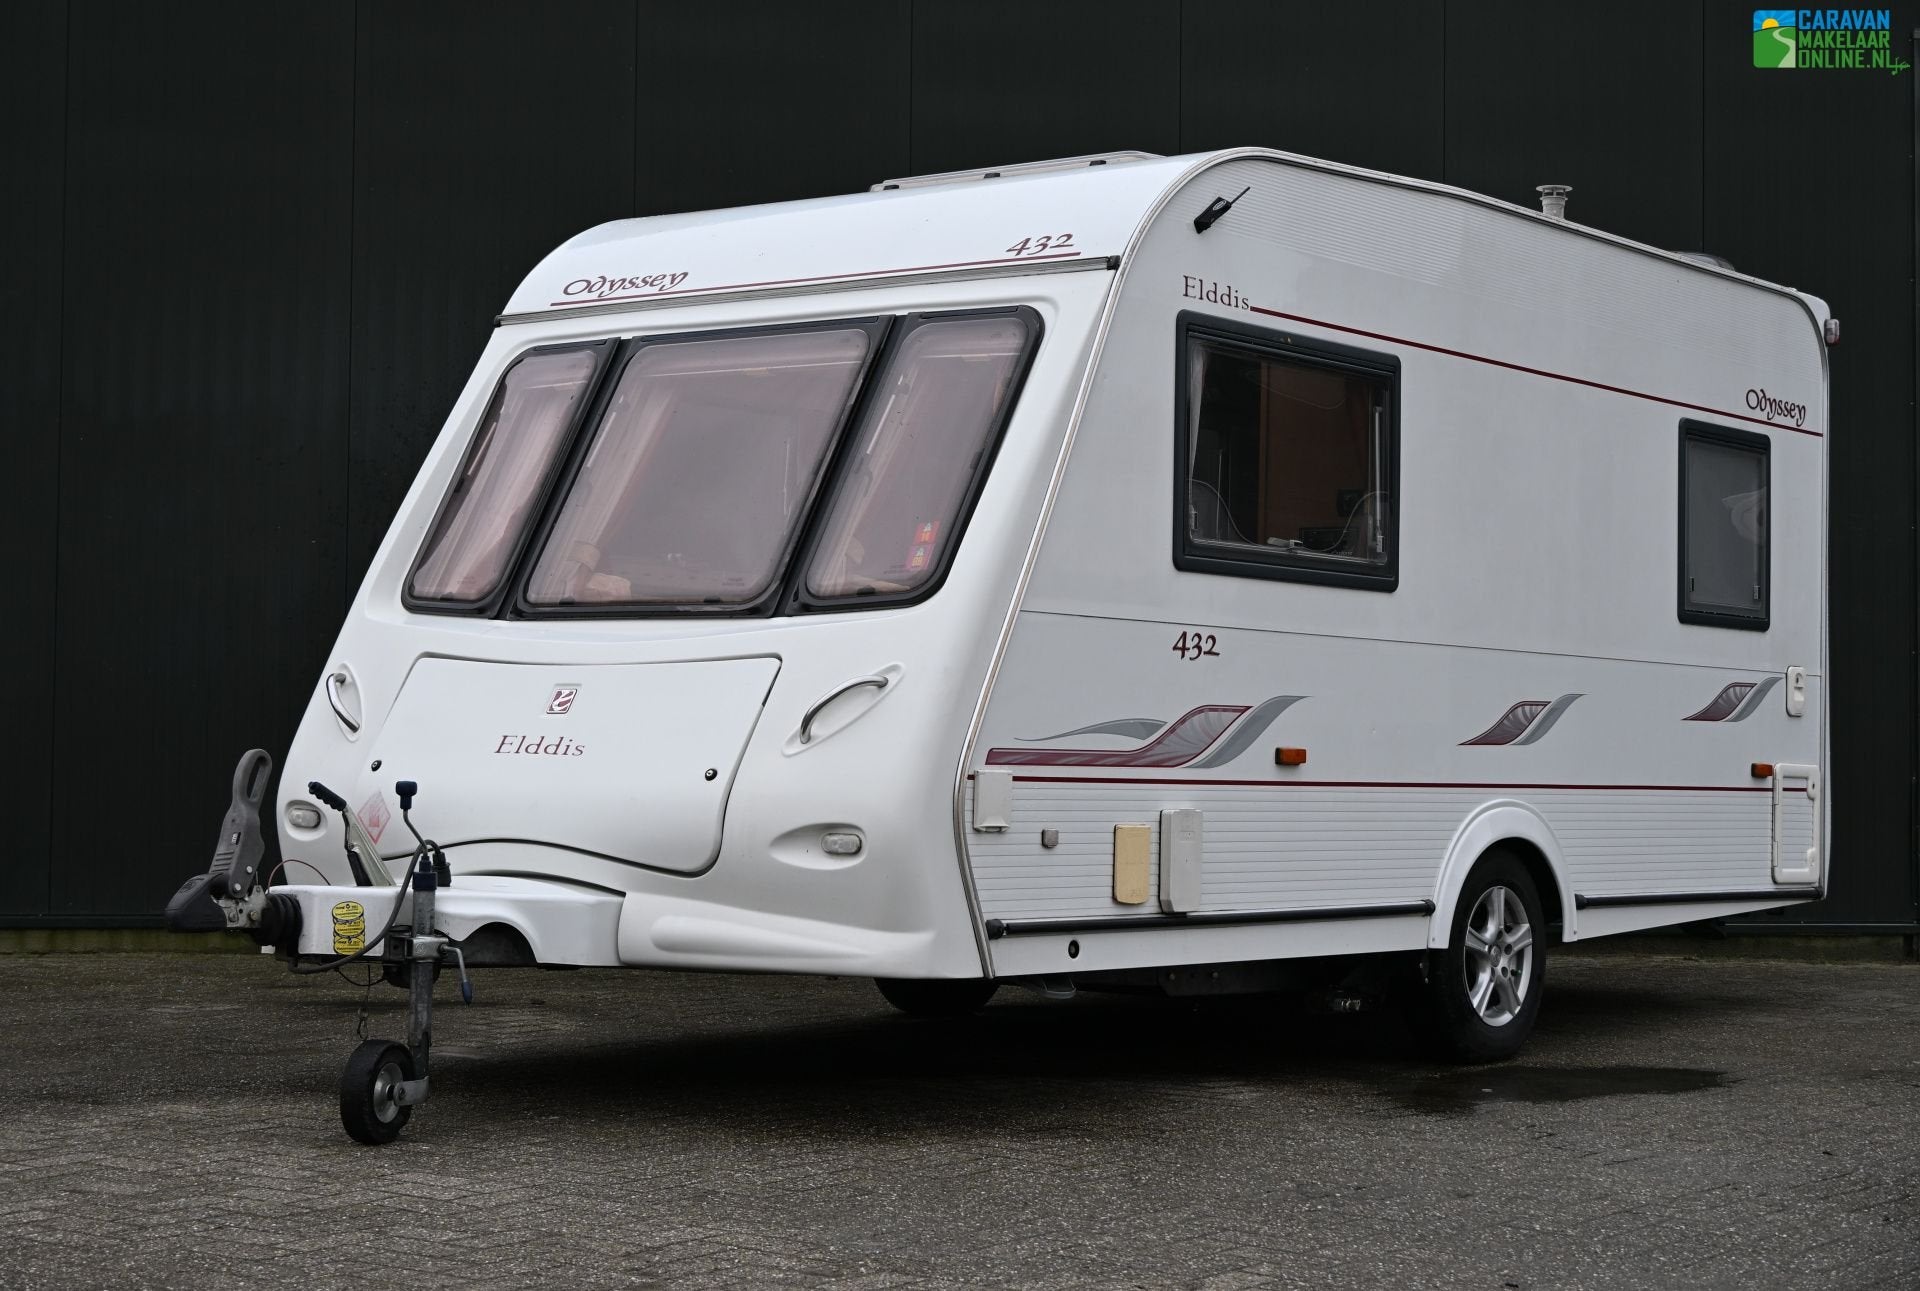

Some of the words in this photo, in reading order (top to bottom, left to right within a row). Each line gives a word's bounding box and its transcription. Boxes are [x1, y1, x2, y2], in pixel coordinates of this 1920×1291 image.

[1005, 233, 1074, 256] 432
[562, 271, 689, 298] Odyssey
[1182, 275, 1250, 310] Elddis
[1745, 388, 1807, 427] Odyssey
[1172, 630, 1221, 661] 432
[494, 734, 586, 757] Elddis
